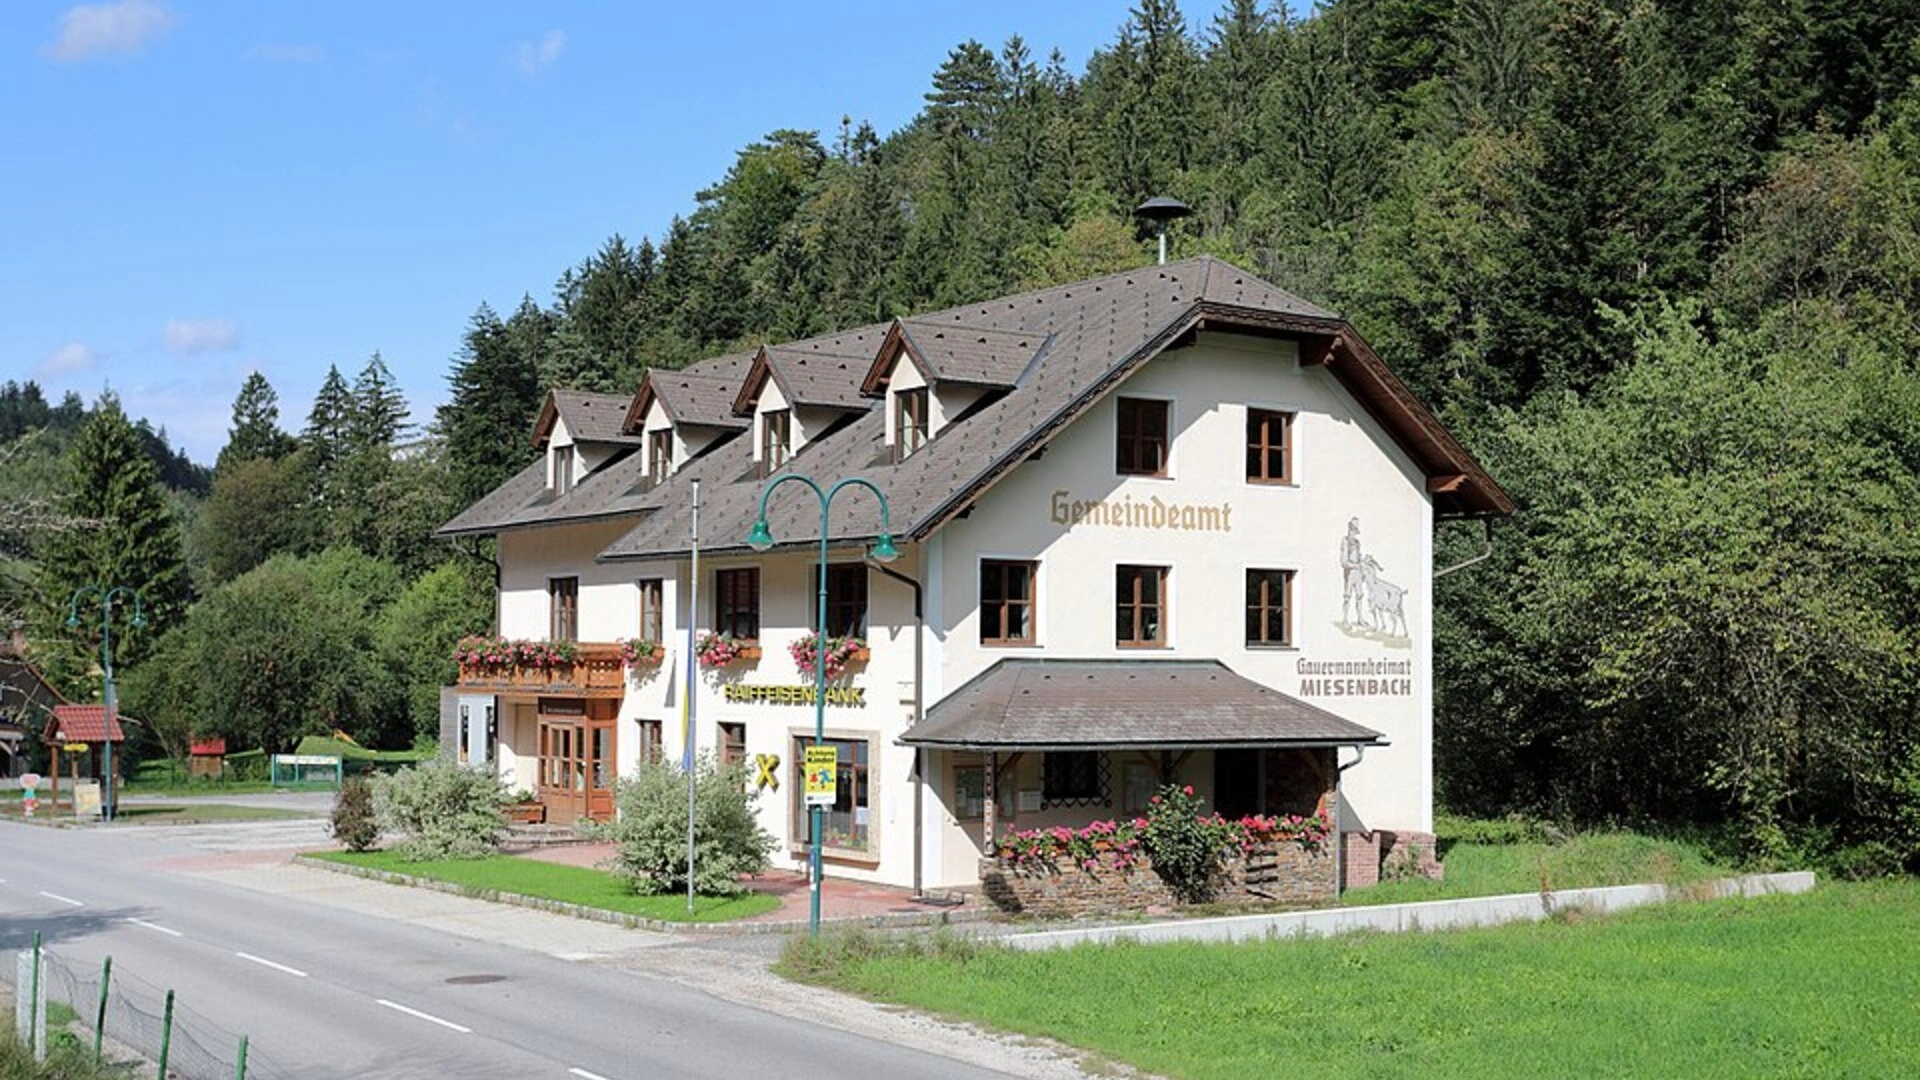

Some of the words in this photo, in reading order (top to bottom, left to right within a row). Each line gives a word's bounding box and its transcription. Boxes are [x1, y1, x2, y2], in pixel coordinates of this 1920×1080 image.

[1051, 489, 1232, 532] Gemeindeamt
[1296, 657, 1412, 675] Gauermannheimat
[1299, 679, 1411, 696] MIESENBACH
